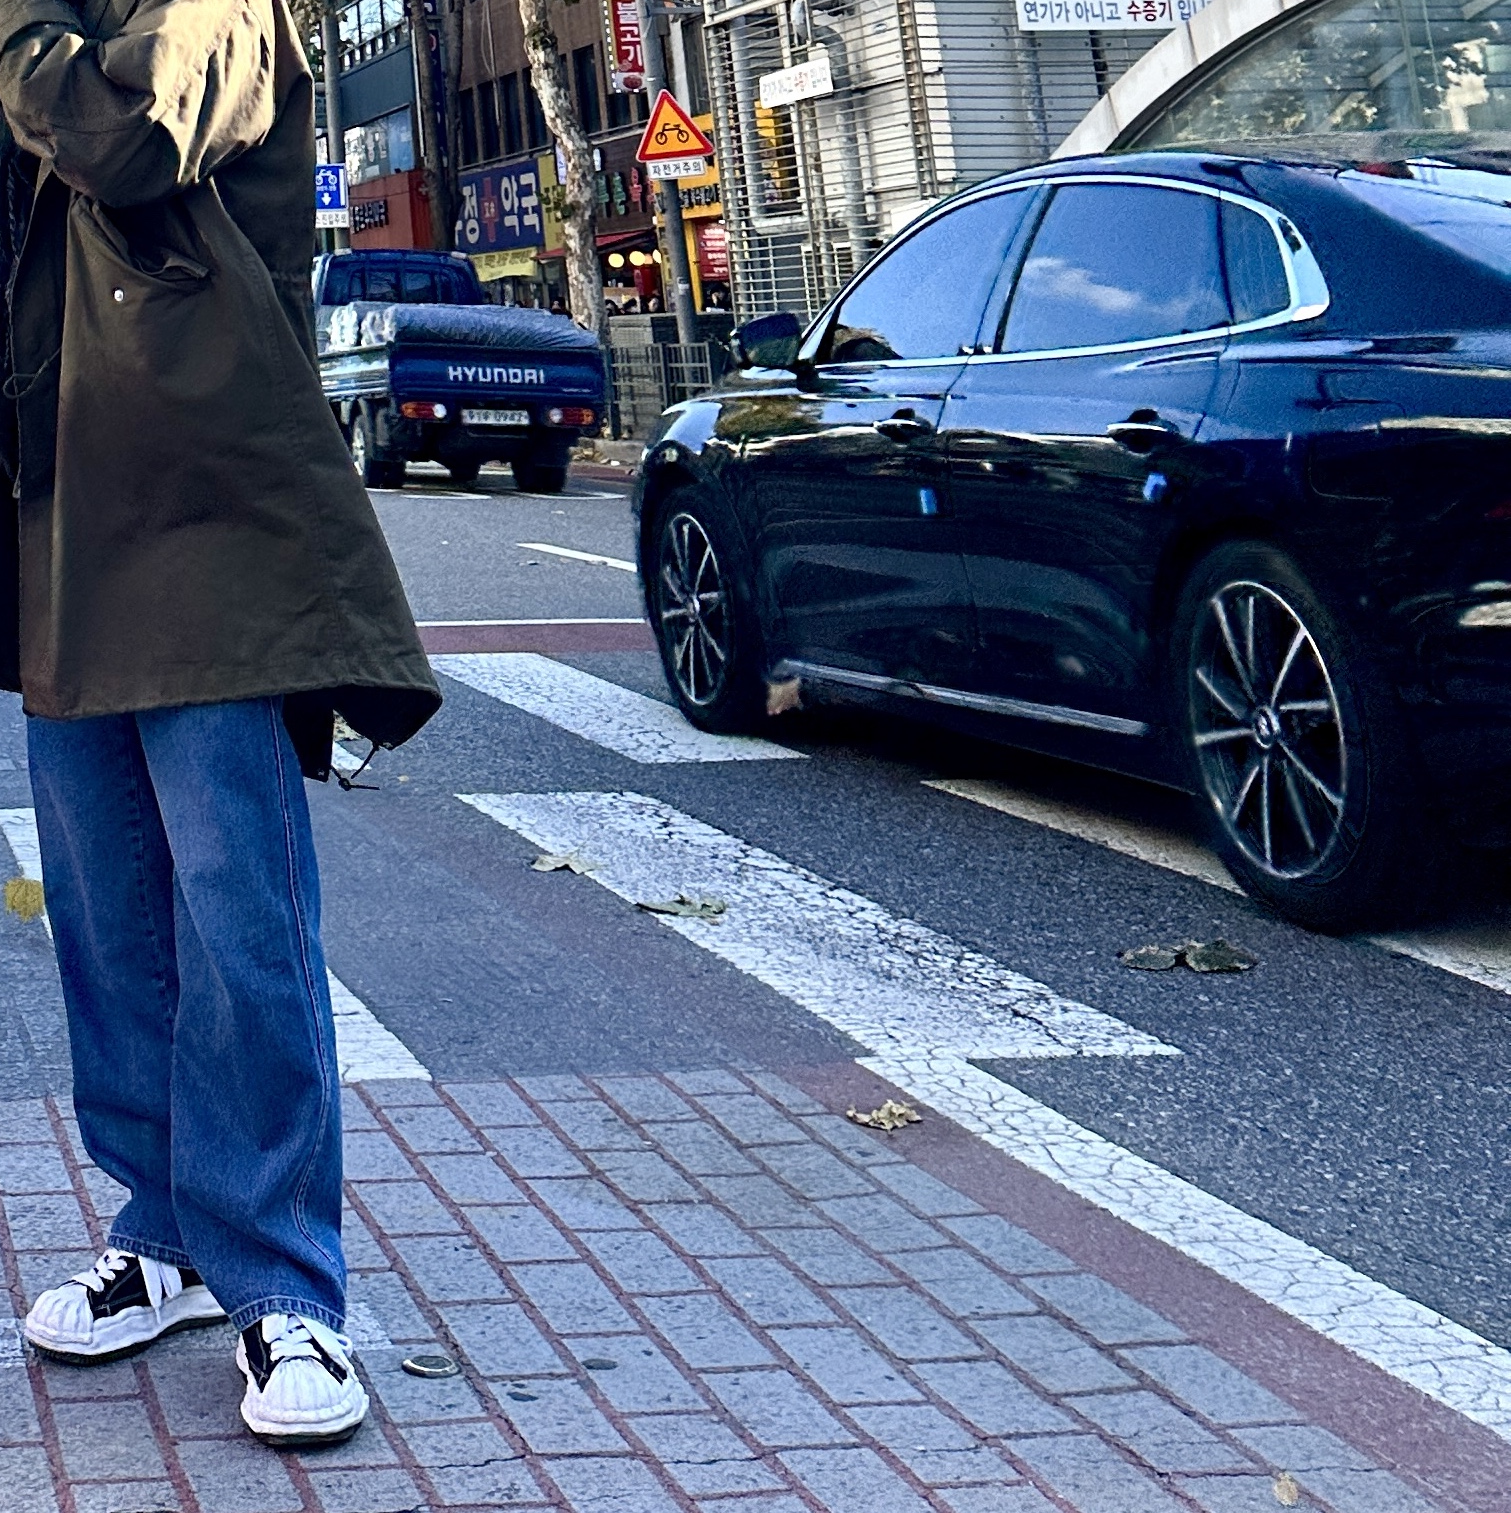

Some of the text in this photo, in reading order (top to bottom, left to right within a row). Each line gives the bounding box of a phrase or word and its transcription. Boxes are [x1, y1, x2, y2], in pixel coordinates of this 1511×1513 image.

[1023, 1, 1070, 23] 연기가
[1075, 1, 1122, 22] 아니고
[1127, 0, 1173, 22] 수증기
[501, 172, 540, 237] 약국
[448, 366, 545, 384] HYUNDAI
